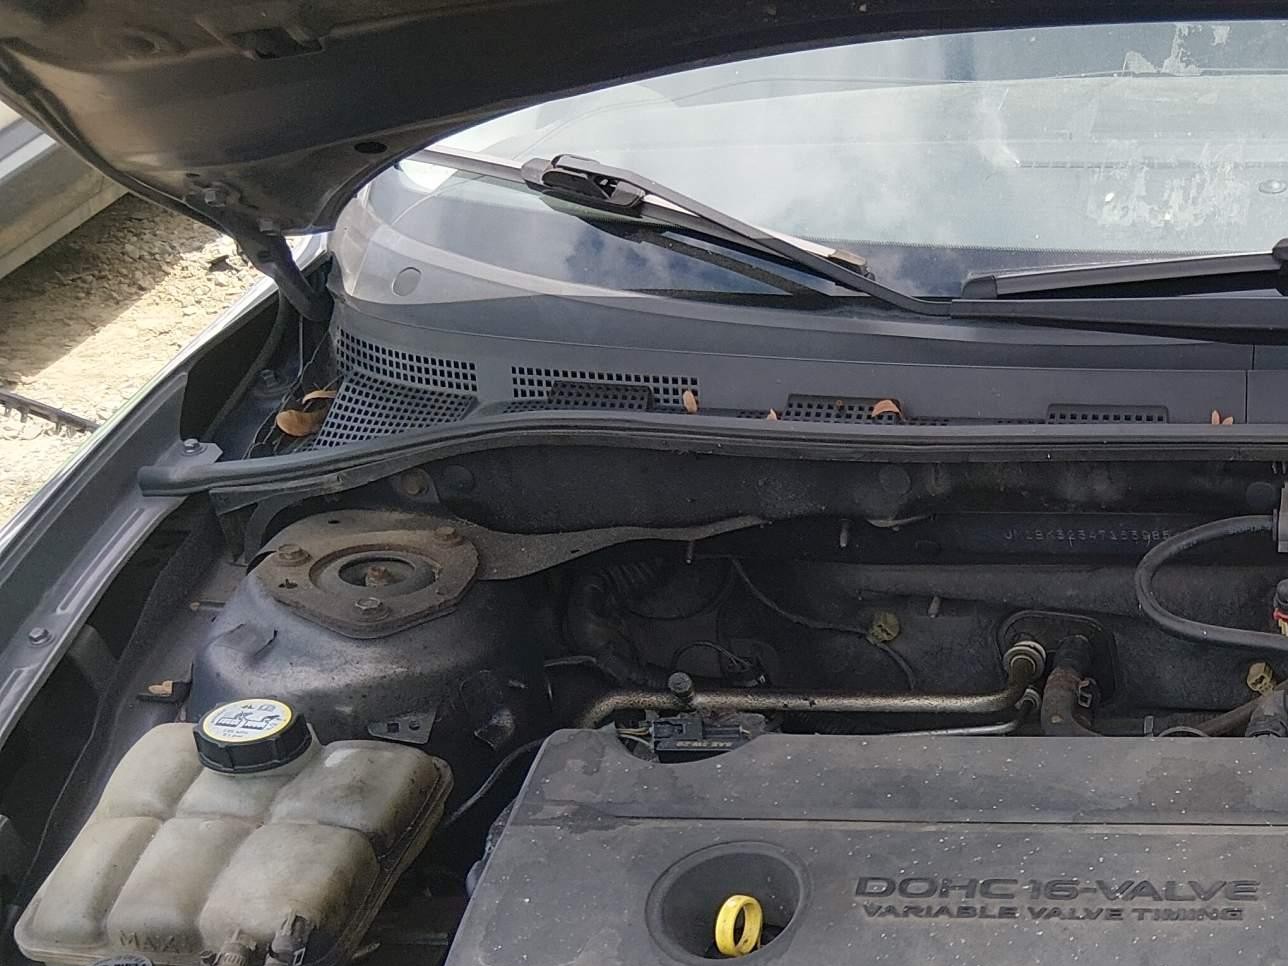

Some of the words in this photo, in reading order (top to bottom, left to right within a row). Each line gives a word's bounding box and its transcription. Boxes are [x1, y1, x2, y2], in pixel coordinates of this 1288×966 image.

[854, 876, 1017, 899] DOHC
[1030, 879, 1260, 902] 16-VALVE
[862, 904, 1019, 919] VARIABLE
[1028, 906, 1125, 921] VALVE
[1132, 907, 1244, 921] TIMING
